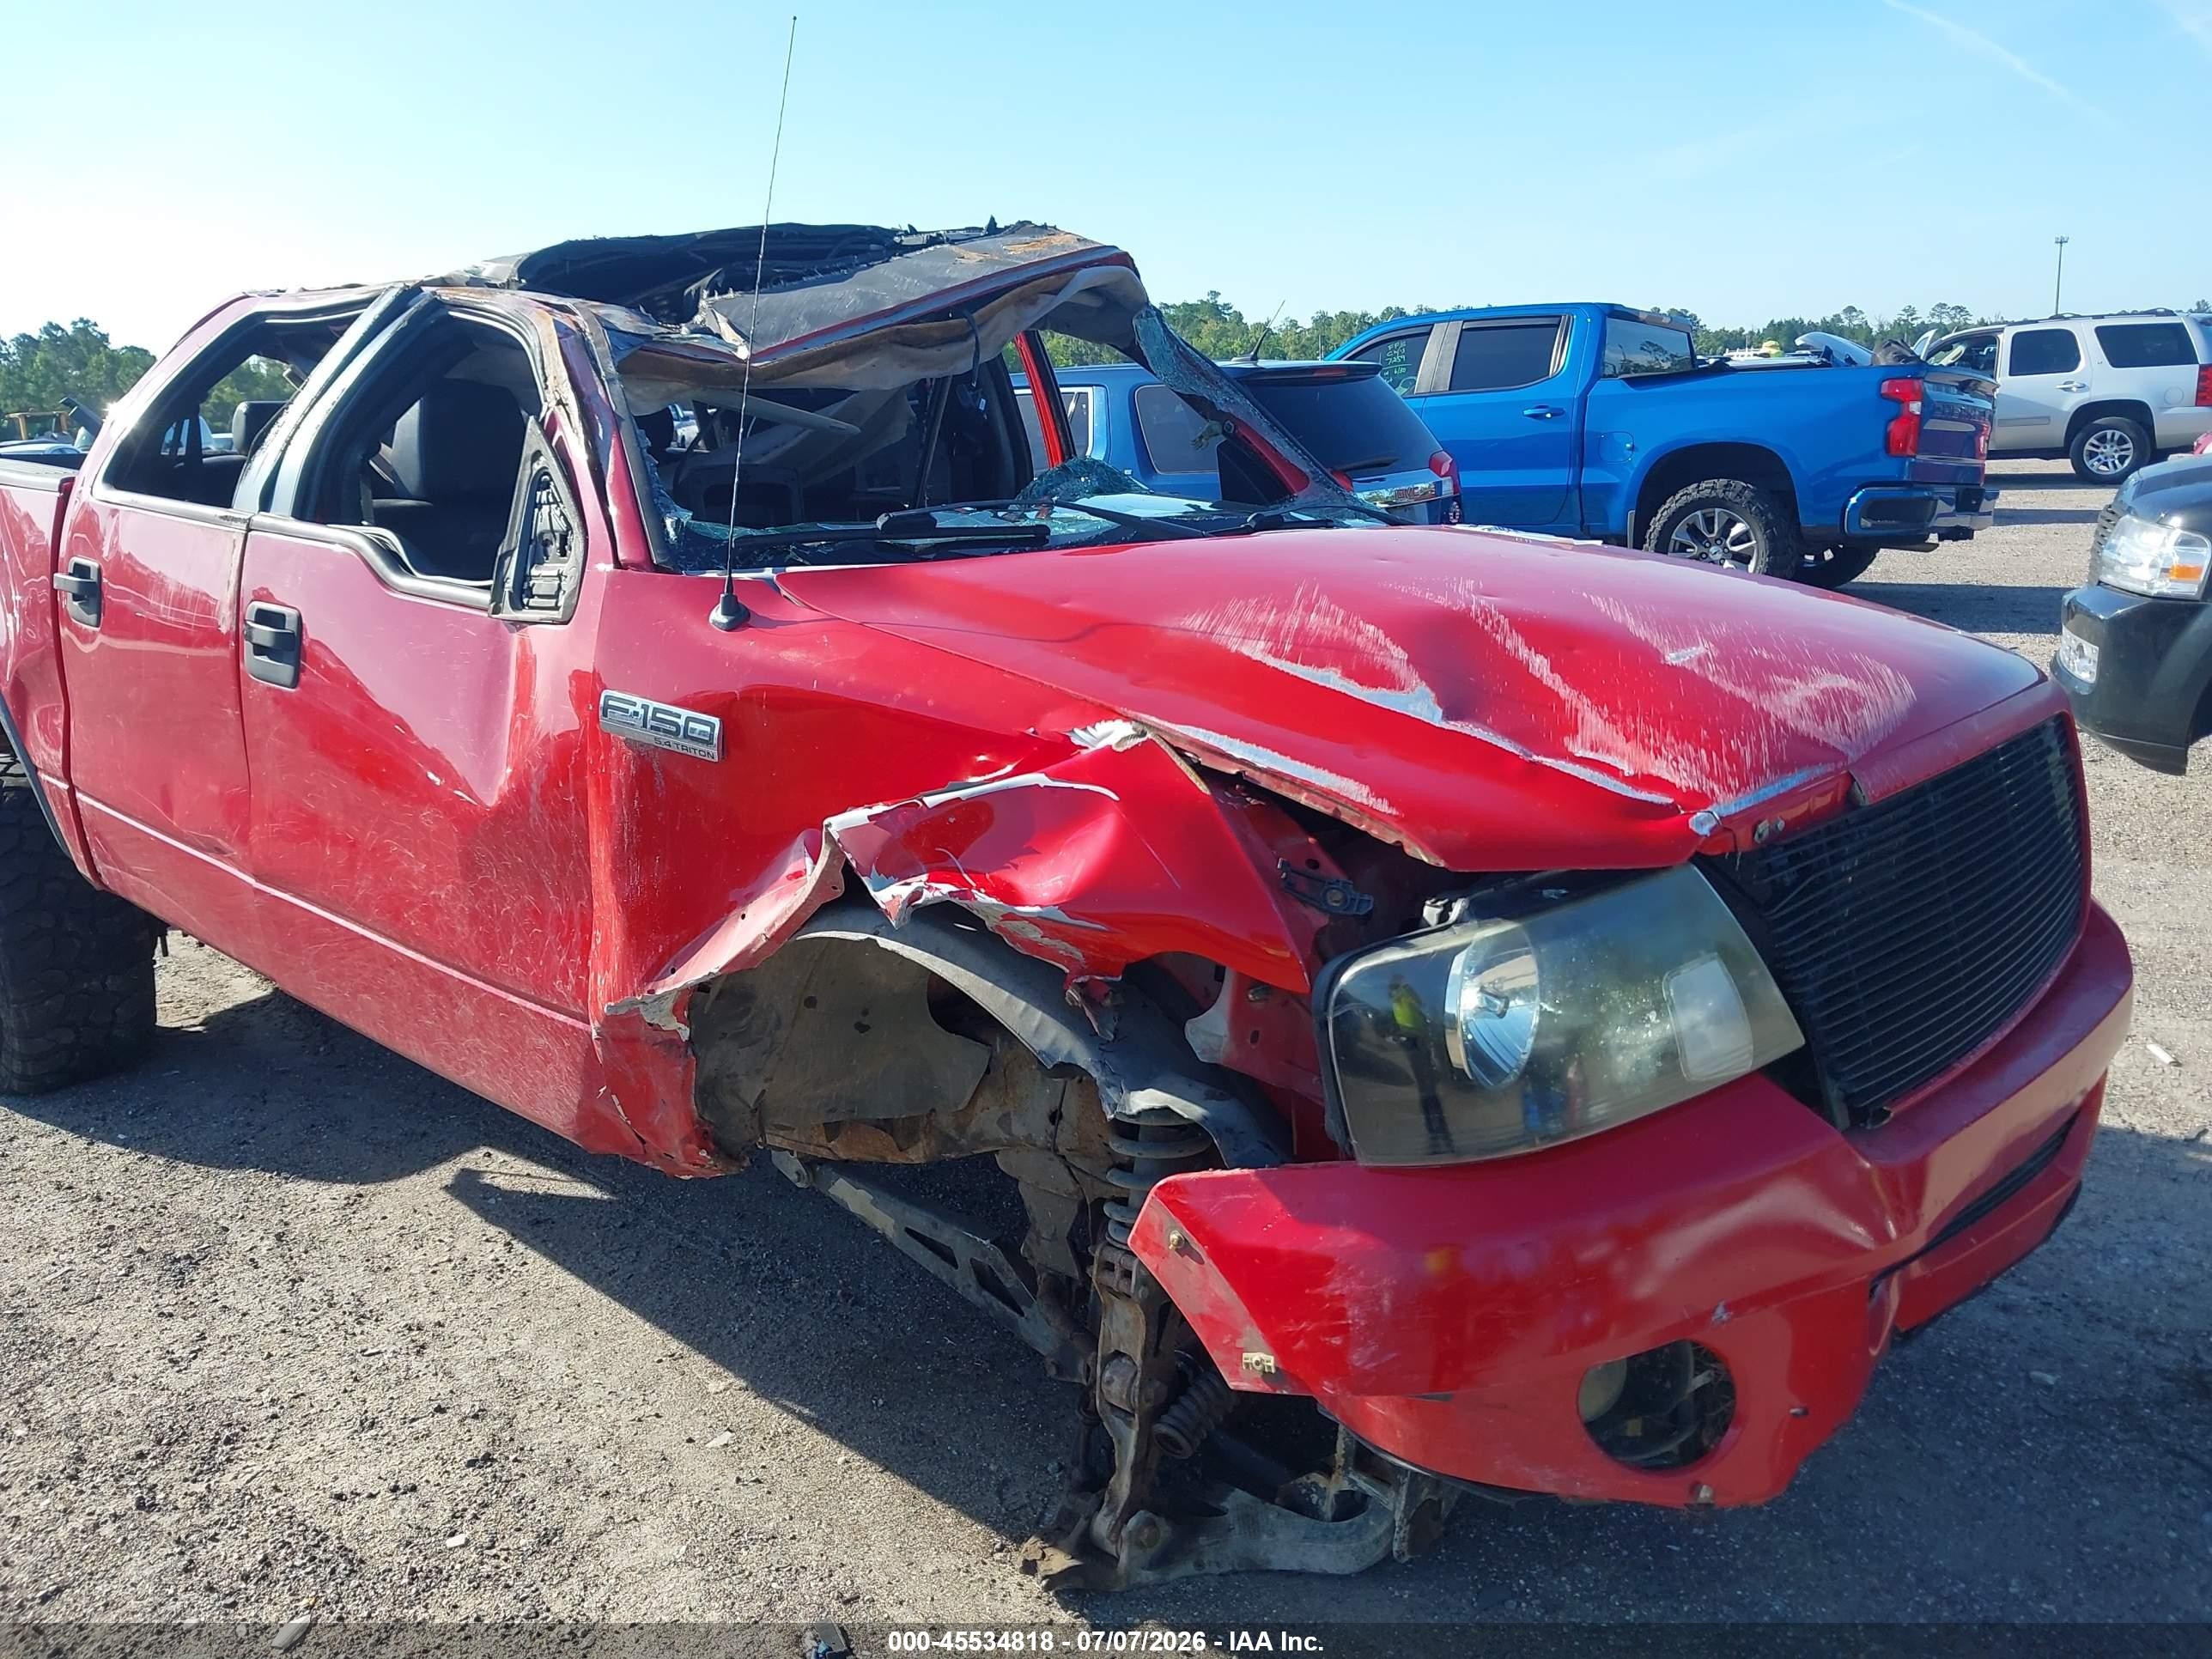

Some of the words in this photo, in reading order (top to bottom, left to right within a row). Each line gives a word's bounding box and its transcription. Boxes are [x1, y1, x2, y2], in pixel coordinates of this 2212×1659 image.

[602, 695, 716, 746] F-150
[653, 738, 672, 748] 5.4
[673, 743, 715, 760] TRITON
